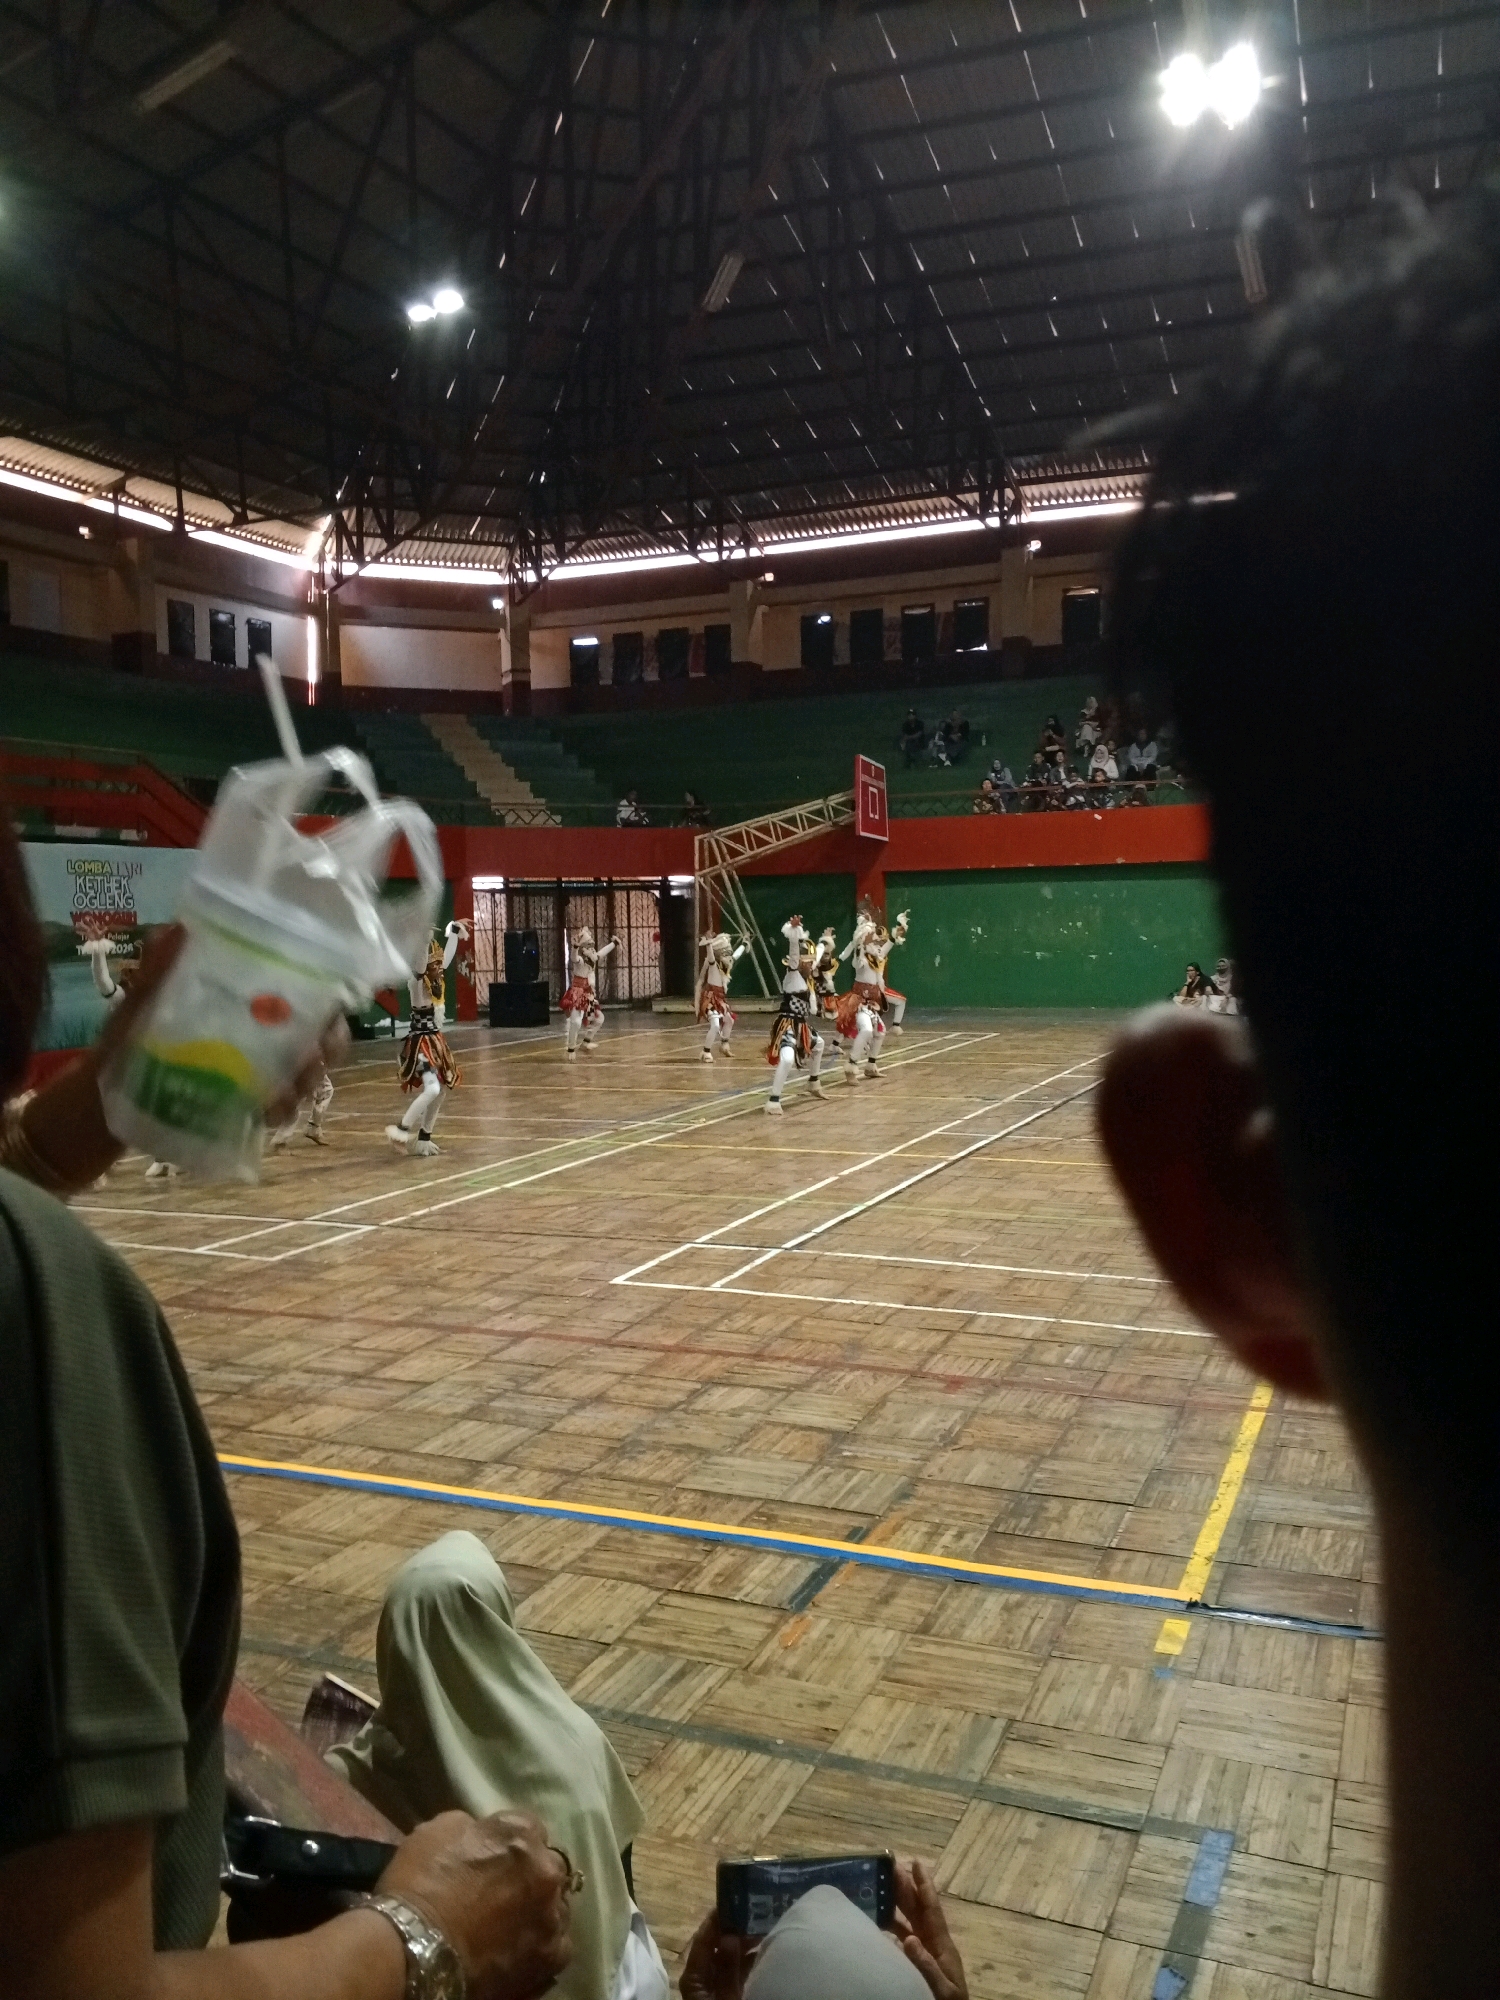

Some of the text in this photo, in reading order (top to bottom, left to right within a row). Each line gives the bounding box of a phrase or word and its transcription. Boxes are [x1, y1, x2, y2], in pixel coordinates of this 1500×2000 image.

[67, 860, 112, 874] LOMBA
[75, 874, 131, 893] KETHEK
[73, 893, 134, 909] OGLENG
